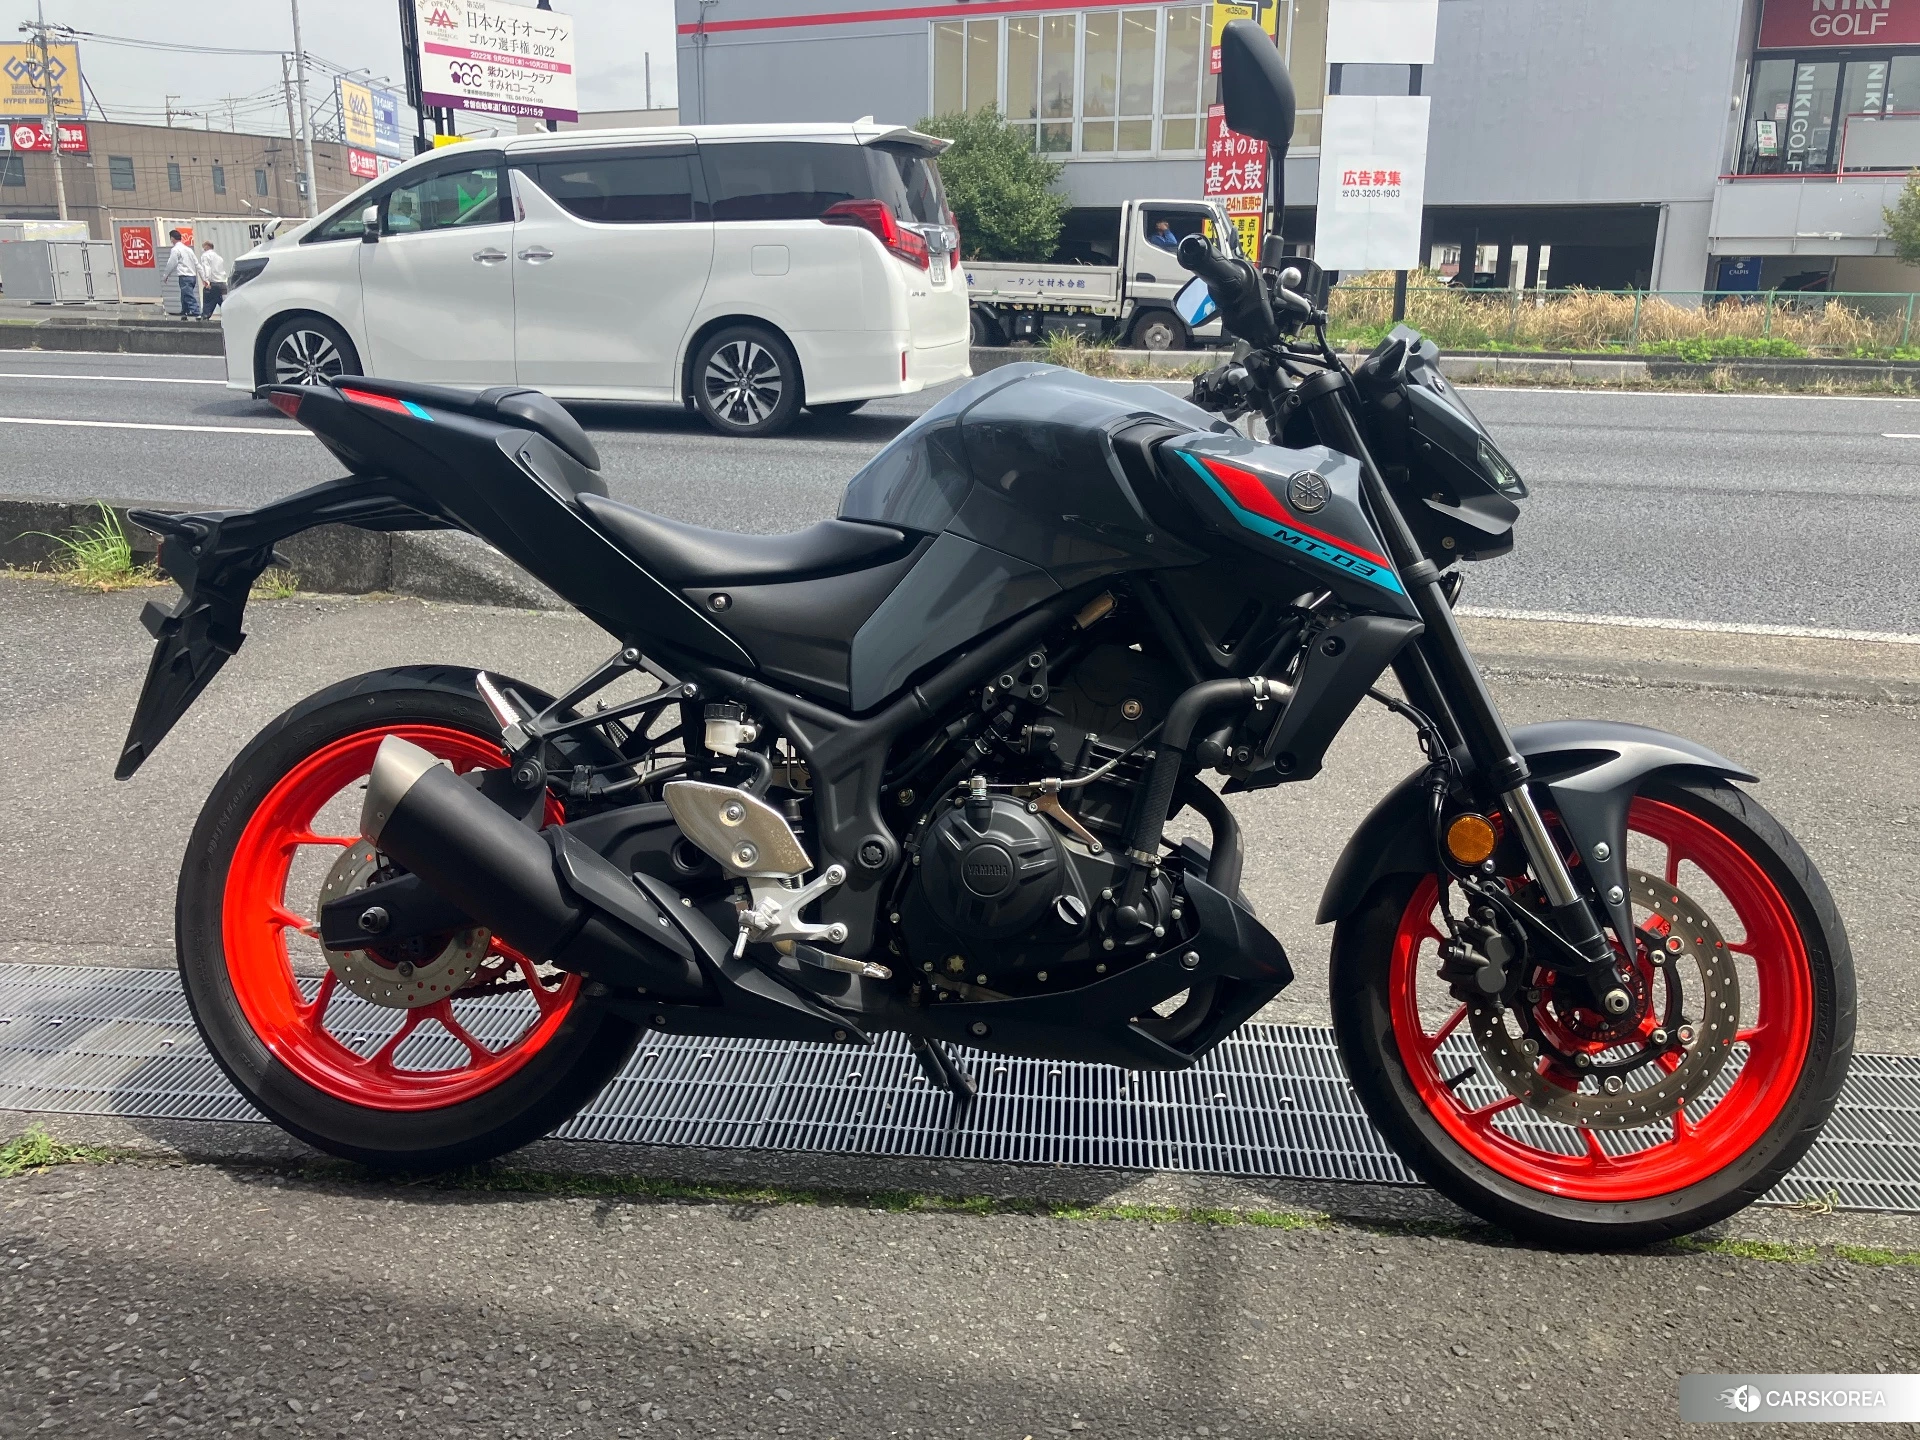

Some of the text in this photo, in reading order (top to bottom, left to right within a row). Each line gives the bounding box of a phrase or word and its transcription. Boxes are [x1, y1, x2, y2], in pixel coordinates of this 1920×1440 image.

[467, 11, 569, 41] 日本女子オープン
[1810, 13, 1888, 36] GOLF
[469, 33, 555, 58] ゴルフ選手権 2022
[470, 51, 492, 61] 2022年
[487, 66, 554, 84] 紫カントリークラブ
[488, 79, 536, 95] すみれコース
[1787, 66, 1816, 172] NIKIGOLF
[1206, 159, 1263, 193] 甚太鼓
[1342, 170, 1402, 186] 広告募集
[1350, 189, 1400, 198] 03-3205-1903
[1273, 529, 1377, 577] MT-03
[967, 864, 1008, 876] YAMAHA
